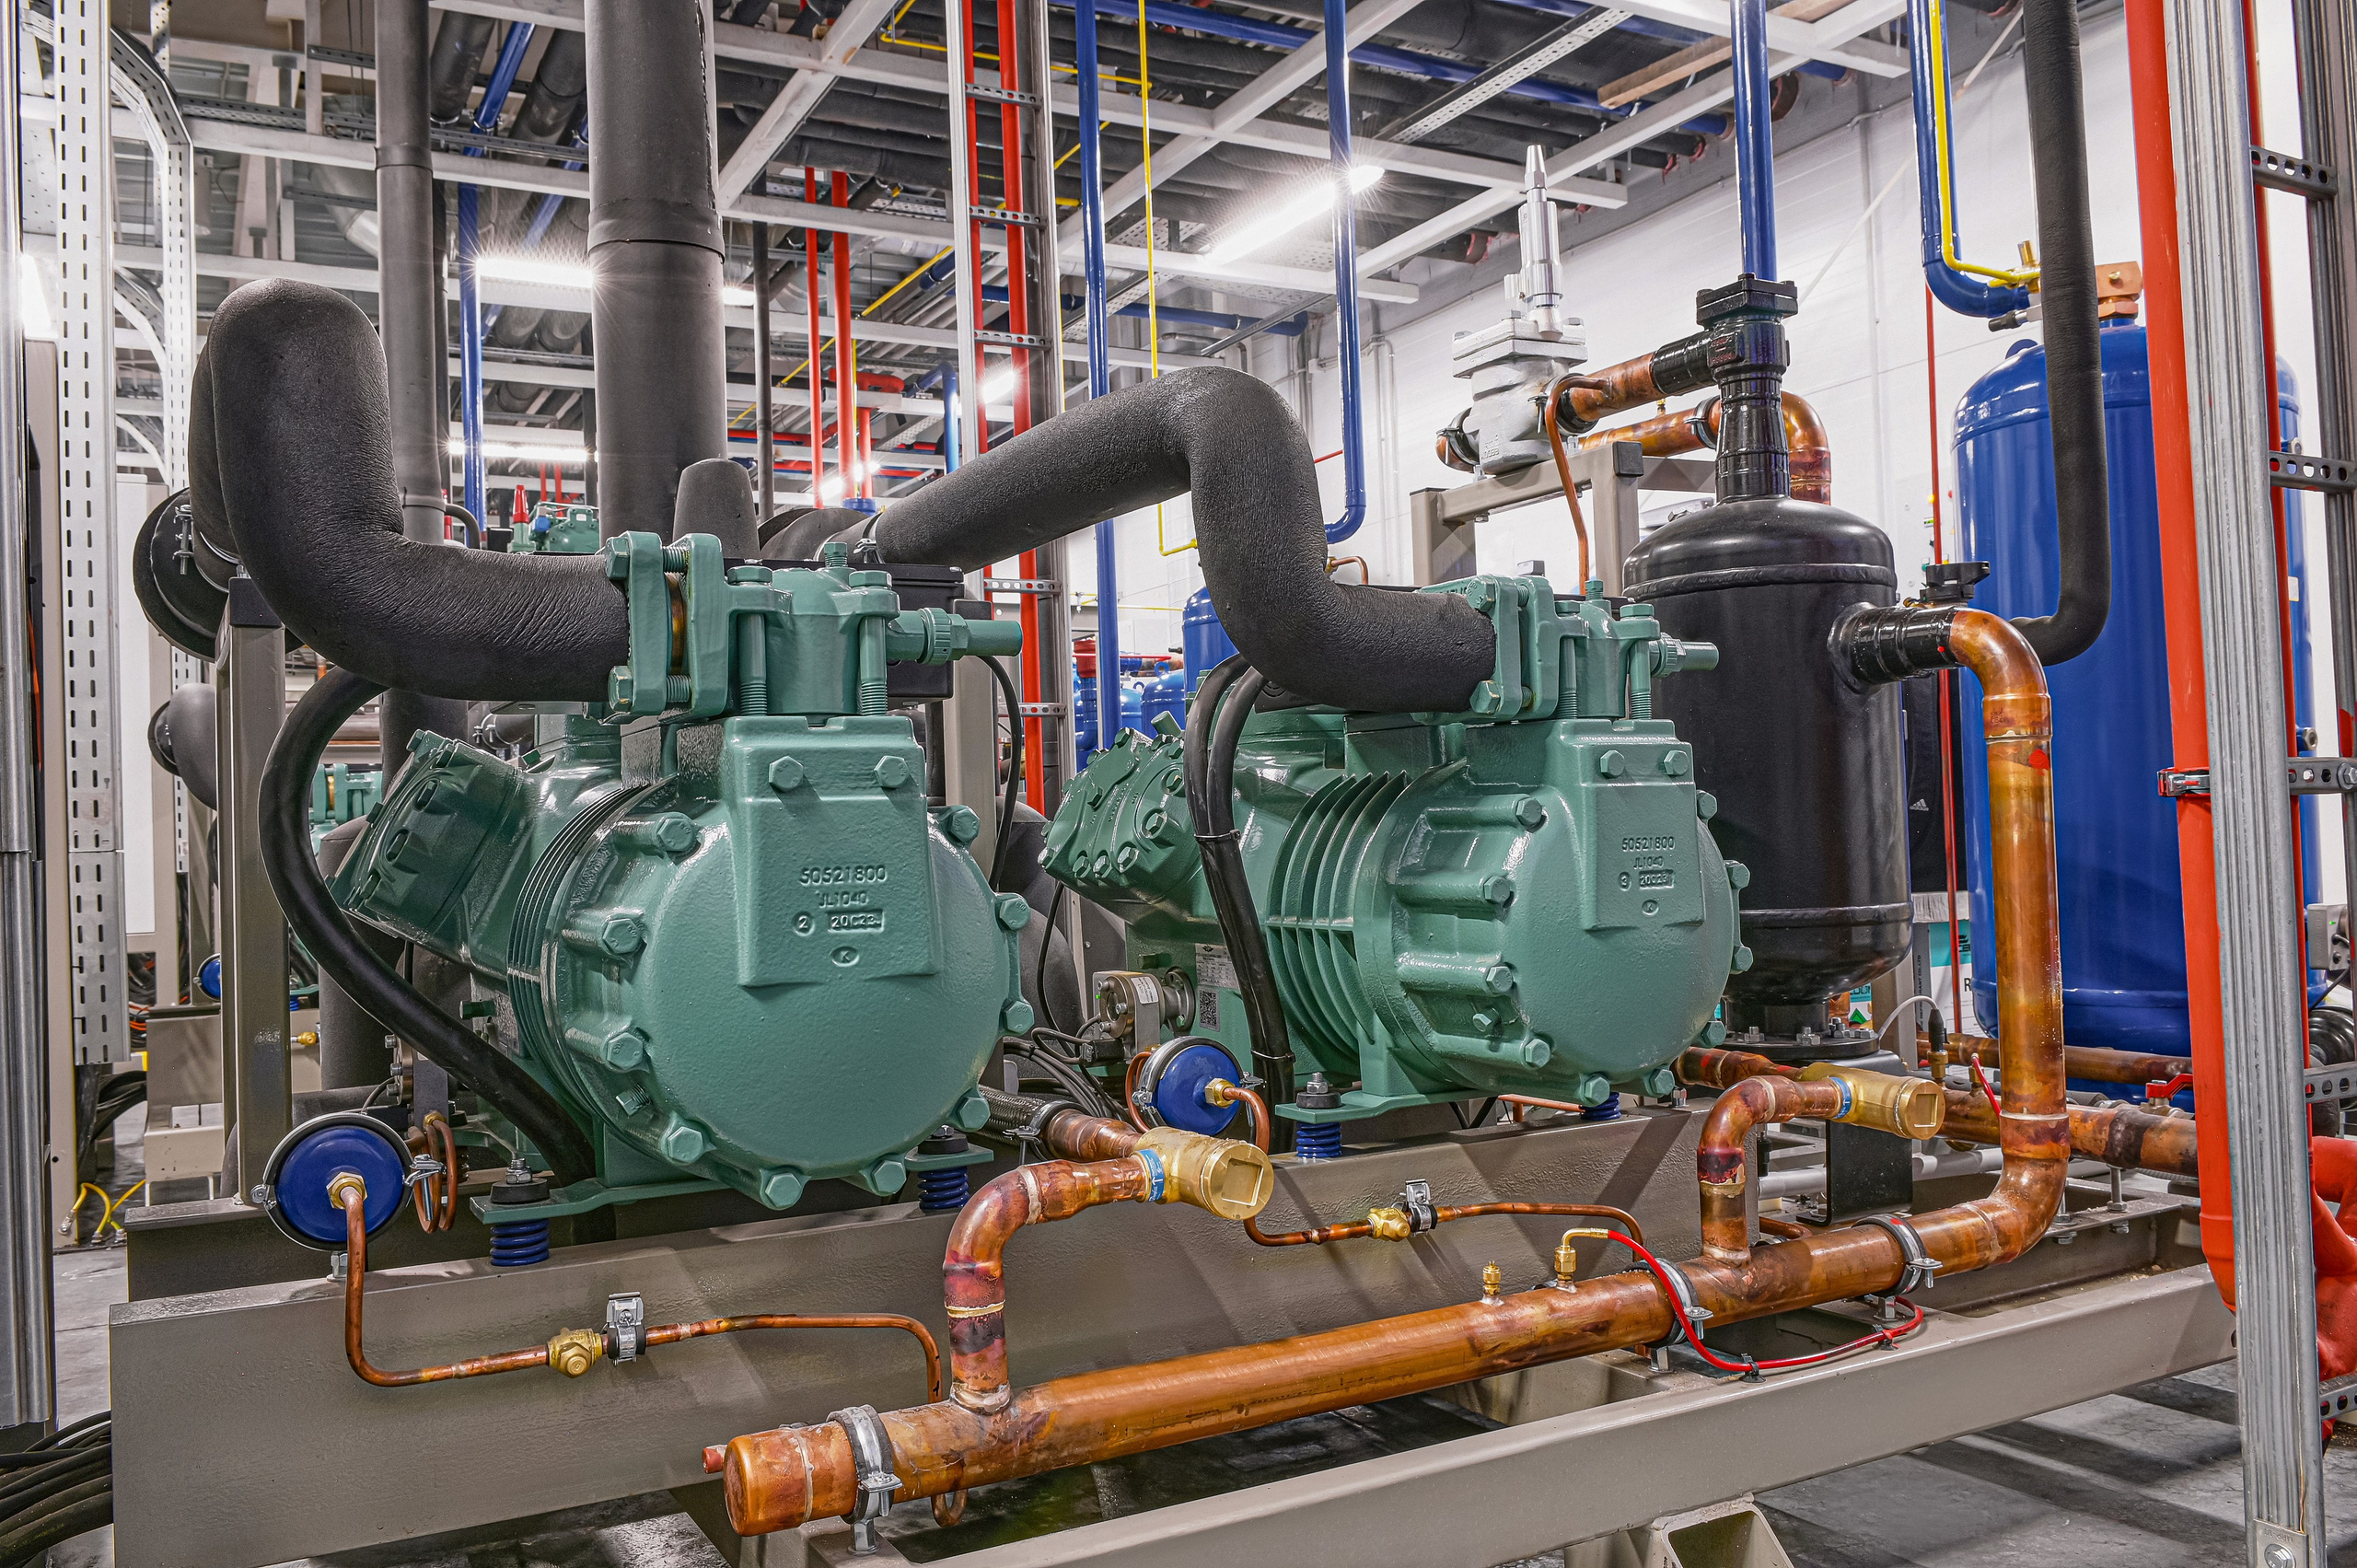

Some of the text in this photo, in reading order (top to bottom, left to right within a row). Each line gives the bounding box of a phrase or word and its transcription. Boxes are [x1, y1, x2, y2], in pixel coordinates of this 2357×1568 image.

[1621, 836, 1676, 852] 50521800
[799, 865, 888, 886] 50521800
[798, 915, 808, 928] 2
